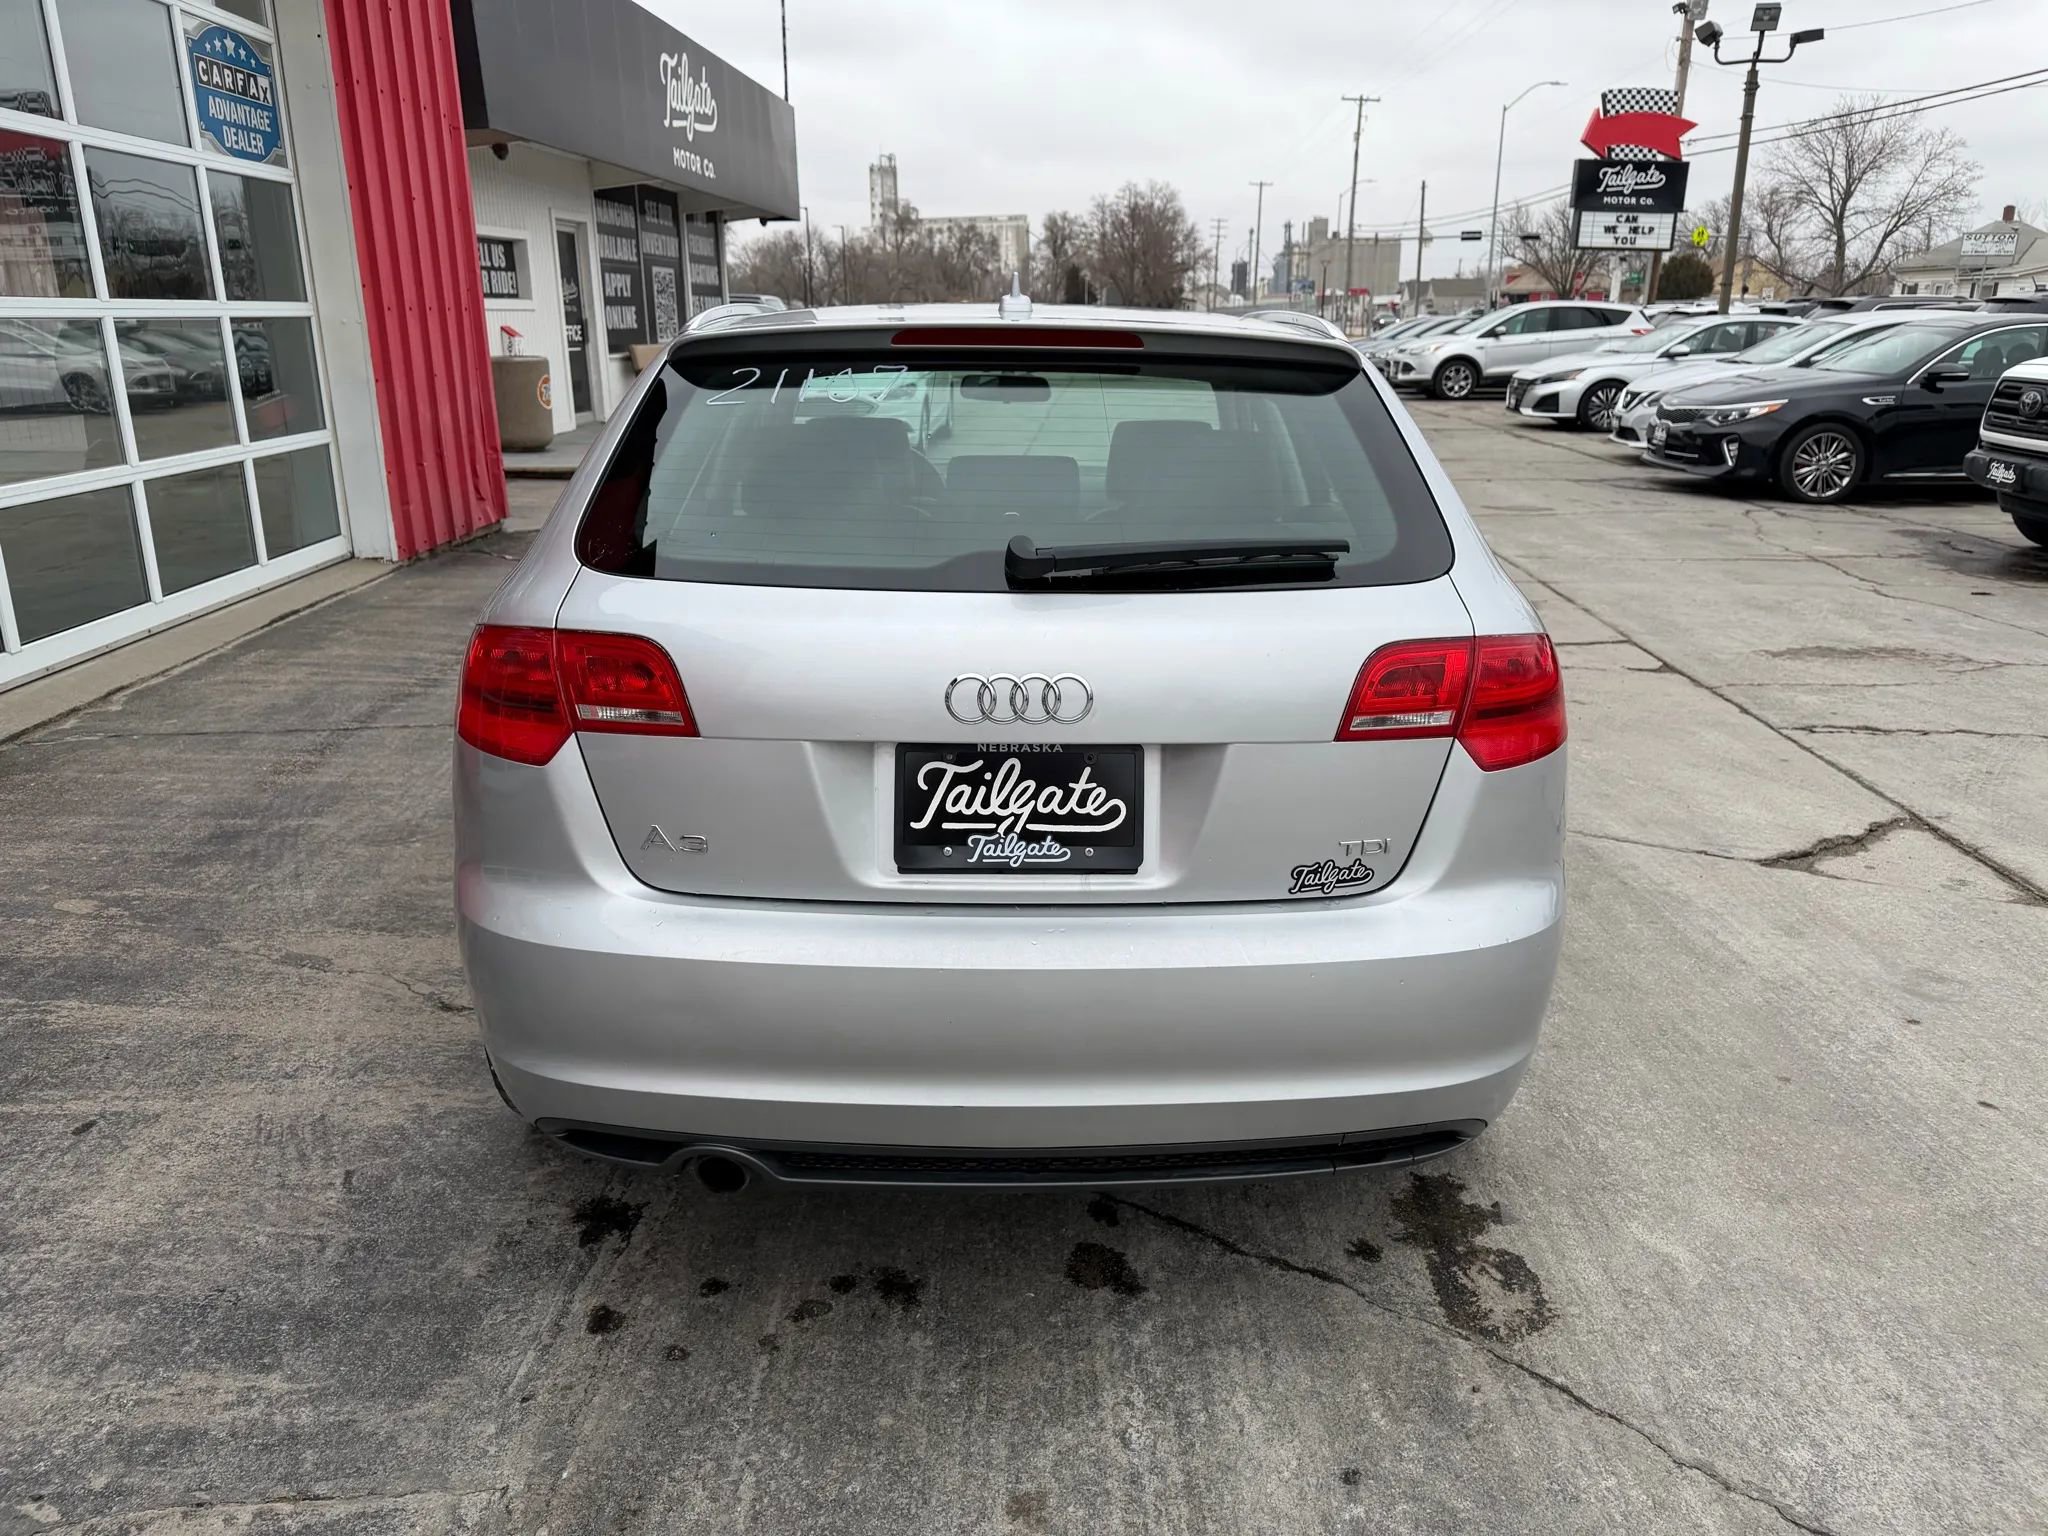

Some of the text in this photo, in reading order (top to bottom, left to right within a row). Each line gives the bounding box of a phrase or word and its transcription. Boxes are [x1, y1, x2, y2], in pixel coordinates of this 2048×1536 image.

[197, 60, 271, 105] CARFAX
[659, 52, 718, 142] Tailgate
[207, 95, 272, 132] ADVANTAGE
[222, 125, 265, 155] DEALER
[672, 146, 702, 174] MOTOR
[1596, 163, 1667, 194] Tailgate
[1603, 196, 1637, 205] MOTOR
[1603, 225, 1655, 236] WE HELP
[1616, 214, 1639, 224] CAN
[1613, 236, 1637, 246] YOU
[1964, 233, 2017, 242] SUTTON
[493, 243, 507, 268] US
[491, 271, 518, 295] RIDE!
[604, 271, 633, 298] APPLY
[605, 305, 639, 330] ONLINE
[1986, 462, 2017, 483] Tailgate
[976, 742, 1064, 753] NEBRASKA
[909, 757, 1127, 840] Tailgate
[640, 824, 709, 853] A3
[967, 832, 1071, 868] Tailgate
[1338, 838, 1392, 857] TDI
[1289, 859, 1374, 893] Tailgate
